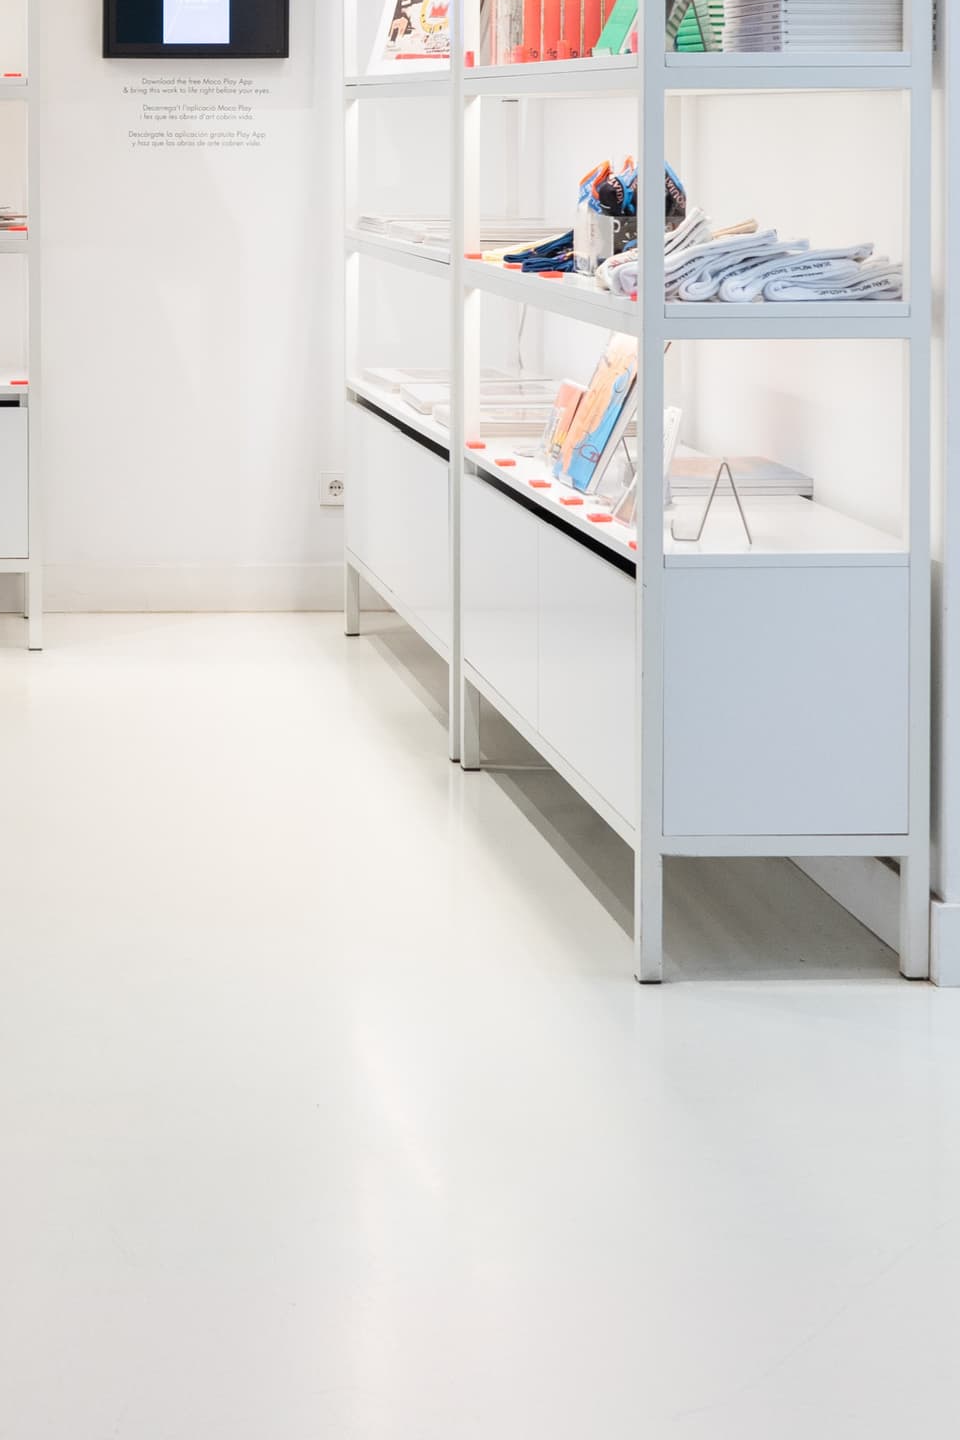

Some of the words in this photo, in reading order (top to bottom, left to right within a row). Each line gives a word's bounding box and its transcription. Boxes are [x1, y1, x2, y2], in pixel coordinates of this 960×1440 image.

[142, 78, 175, 86] Download
[177, 78, 187, 86] the
[188, 78, 201, 86] free
[202, 78, 222, 86] Moco
[223, 78, 236, 86] Play
[238, 78, 253, 86] App
[130, 87, 147, 95] bring
[149, 87, 160, 95] this
[162, 87, 178, 95] work
[180, 87, 186, 95] to
[188, 87, 198, 95] life
[199, 87, 215, 95] right
[216, 87, 236, 95] before
[238, 87, 252, 95] your
[217, 104, 237, 113] Moco
[238, 104, 252, 113] Play
[154, 113, 167, 121] que
[168, 113, 178, 121] les
[179, 113, 198, 121] obres
[166, 130, 173, 139] la
[209, 130, 235, 139] gratuita
[236, 130, 250, 139] Play
[137, 139, 150, 148] haz
[151, 139, 165, 148] que
[165, 139, 175, 148] las
[176, 139, 196, 148] obras
[196, 139, 206, 148] de
[207, 139, 221, 148] arte
